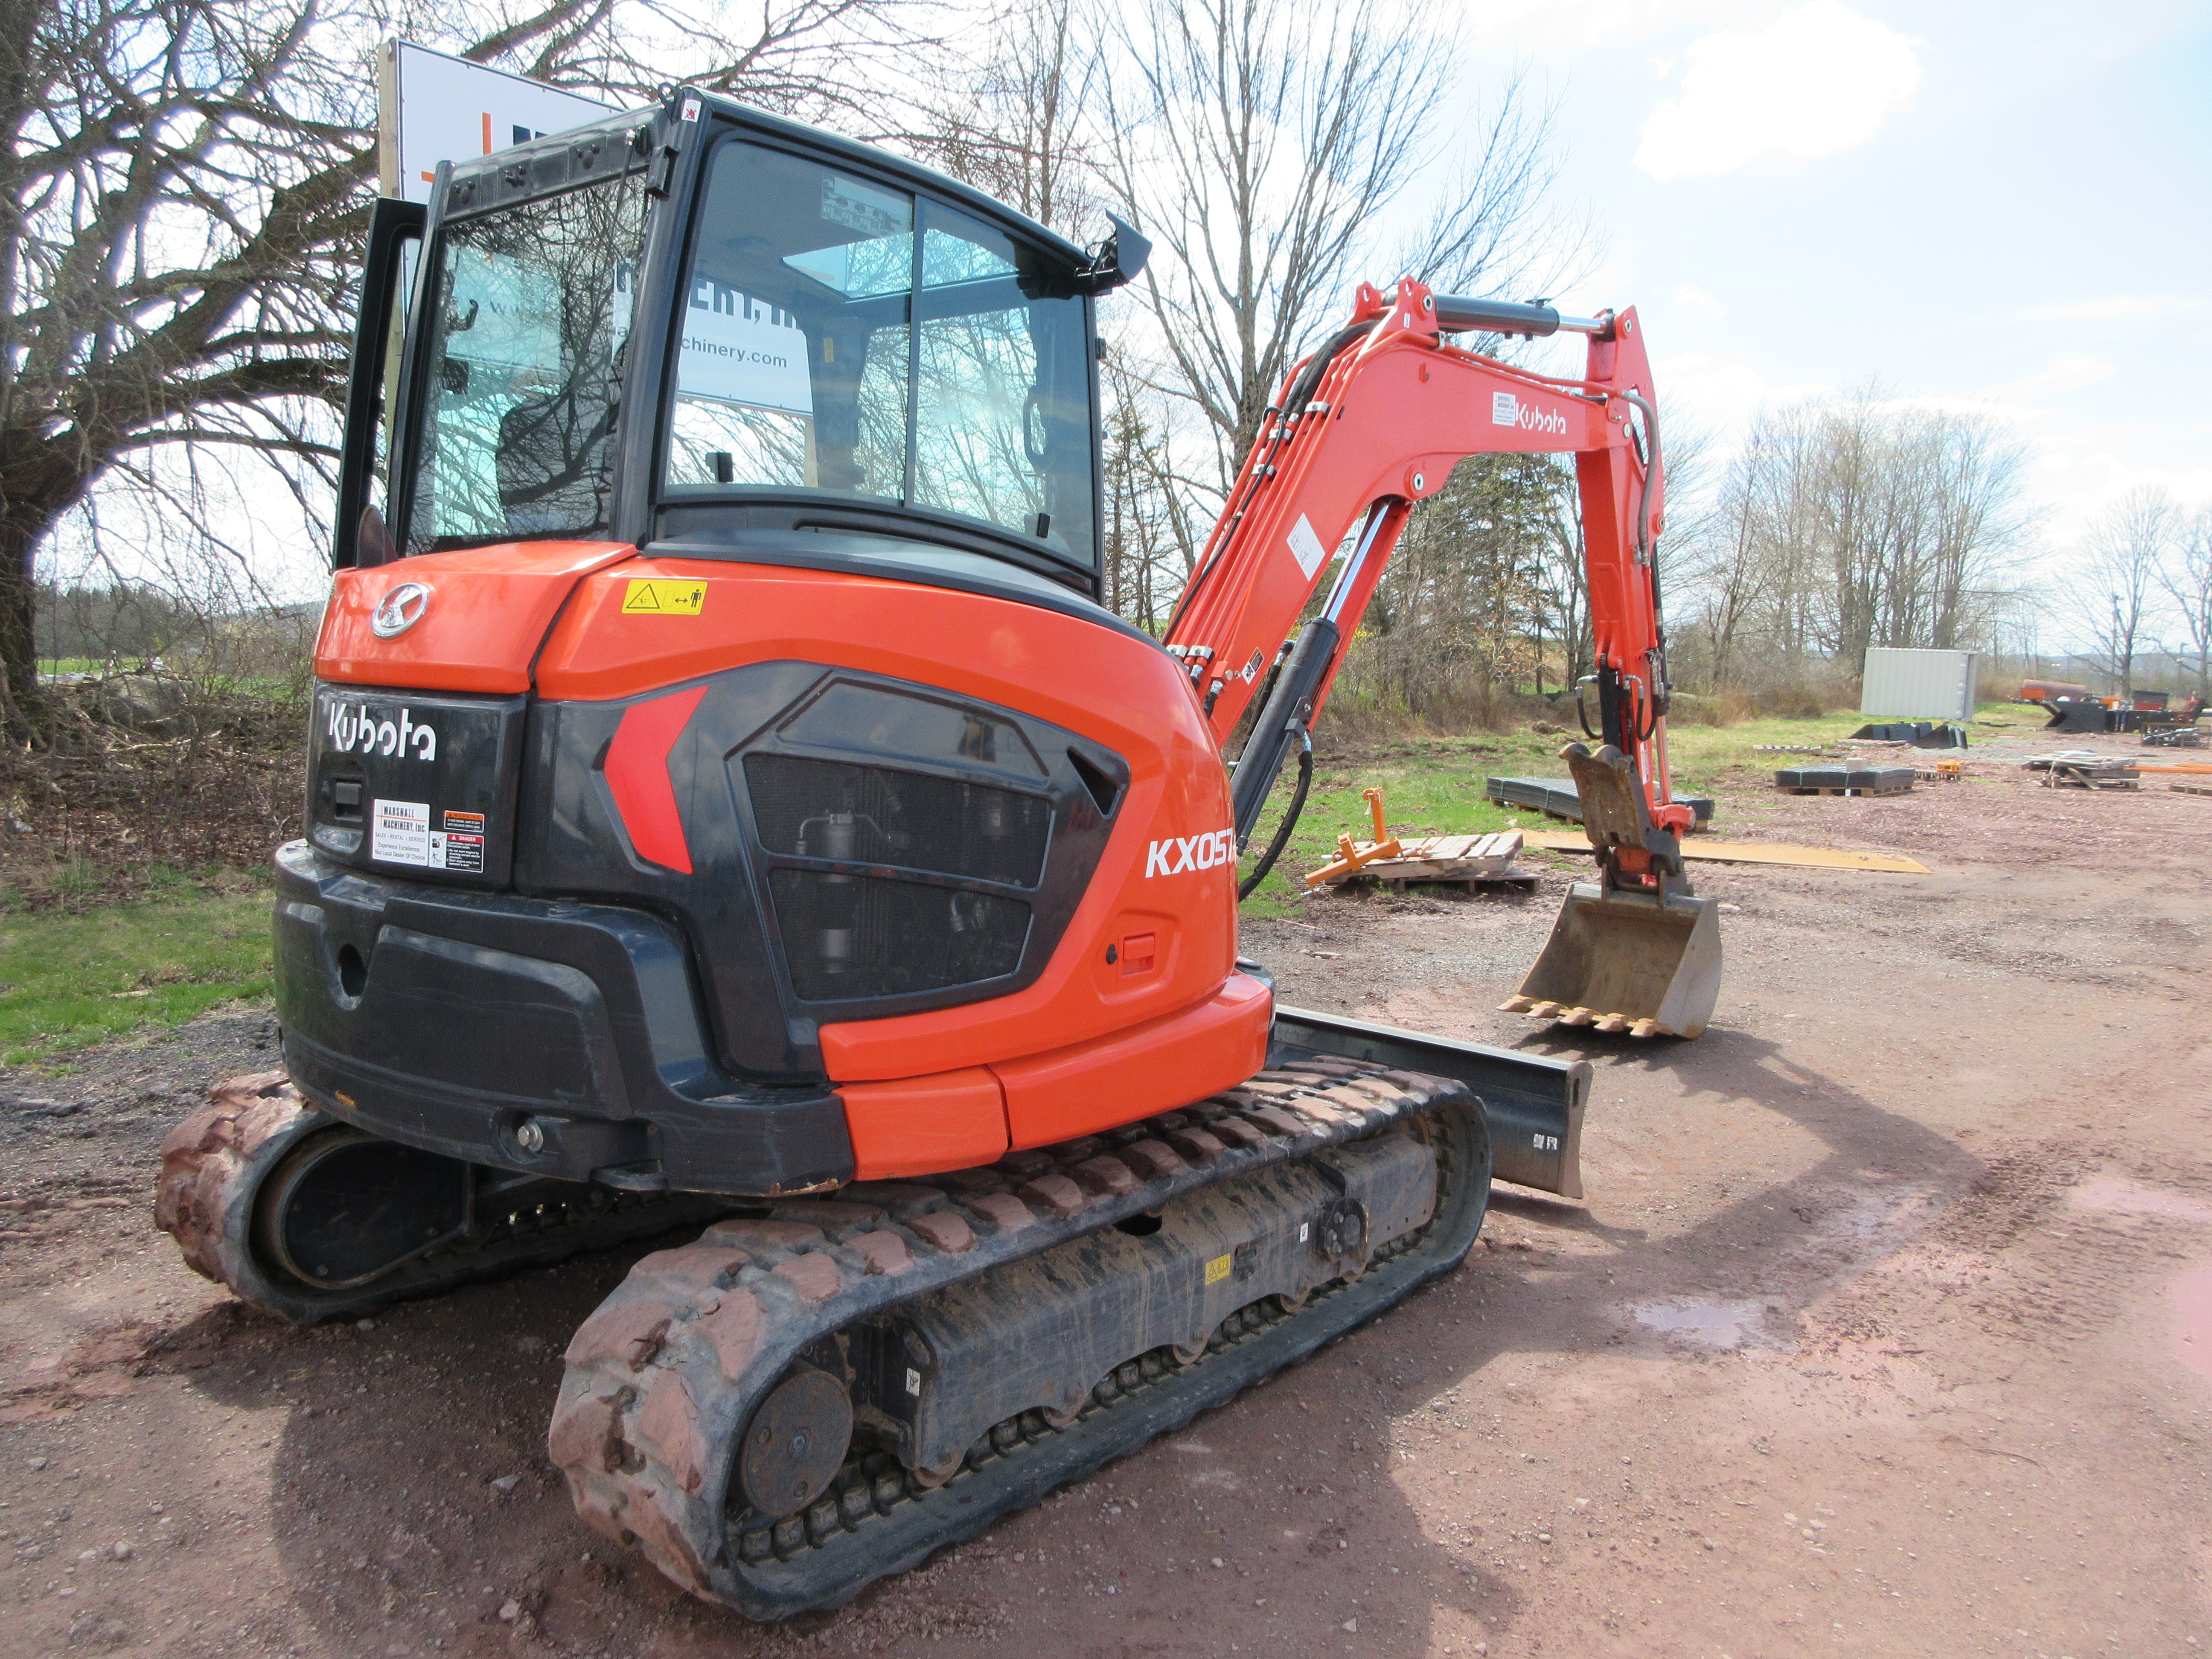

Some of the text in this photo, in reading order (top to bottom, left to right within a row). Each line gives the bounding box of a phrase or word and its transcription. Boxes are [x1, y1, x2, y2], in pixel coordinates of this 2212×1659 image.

[1516, 402, 1566, 434] Kubota
[329, 702, 437, 761] Kubota
[384, 806, 414, 818] MARSHALL
[384, 819, 427, 833] MACHINERY, Inc.
